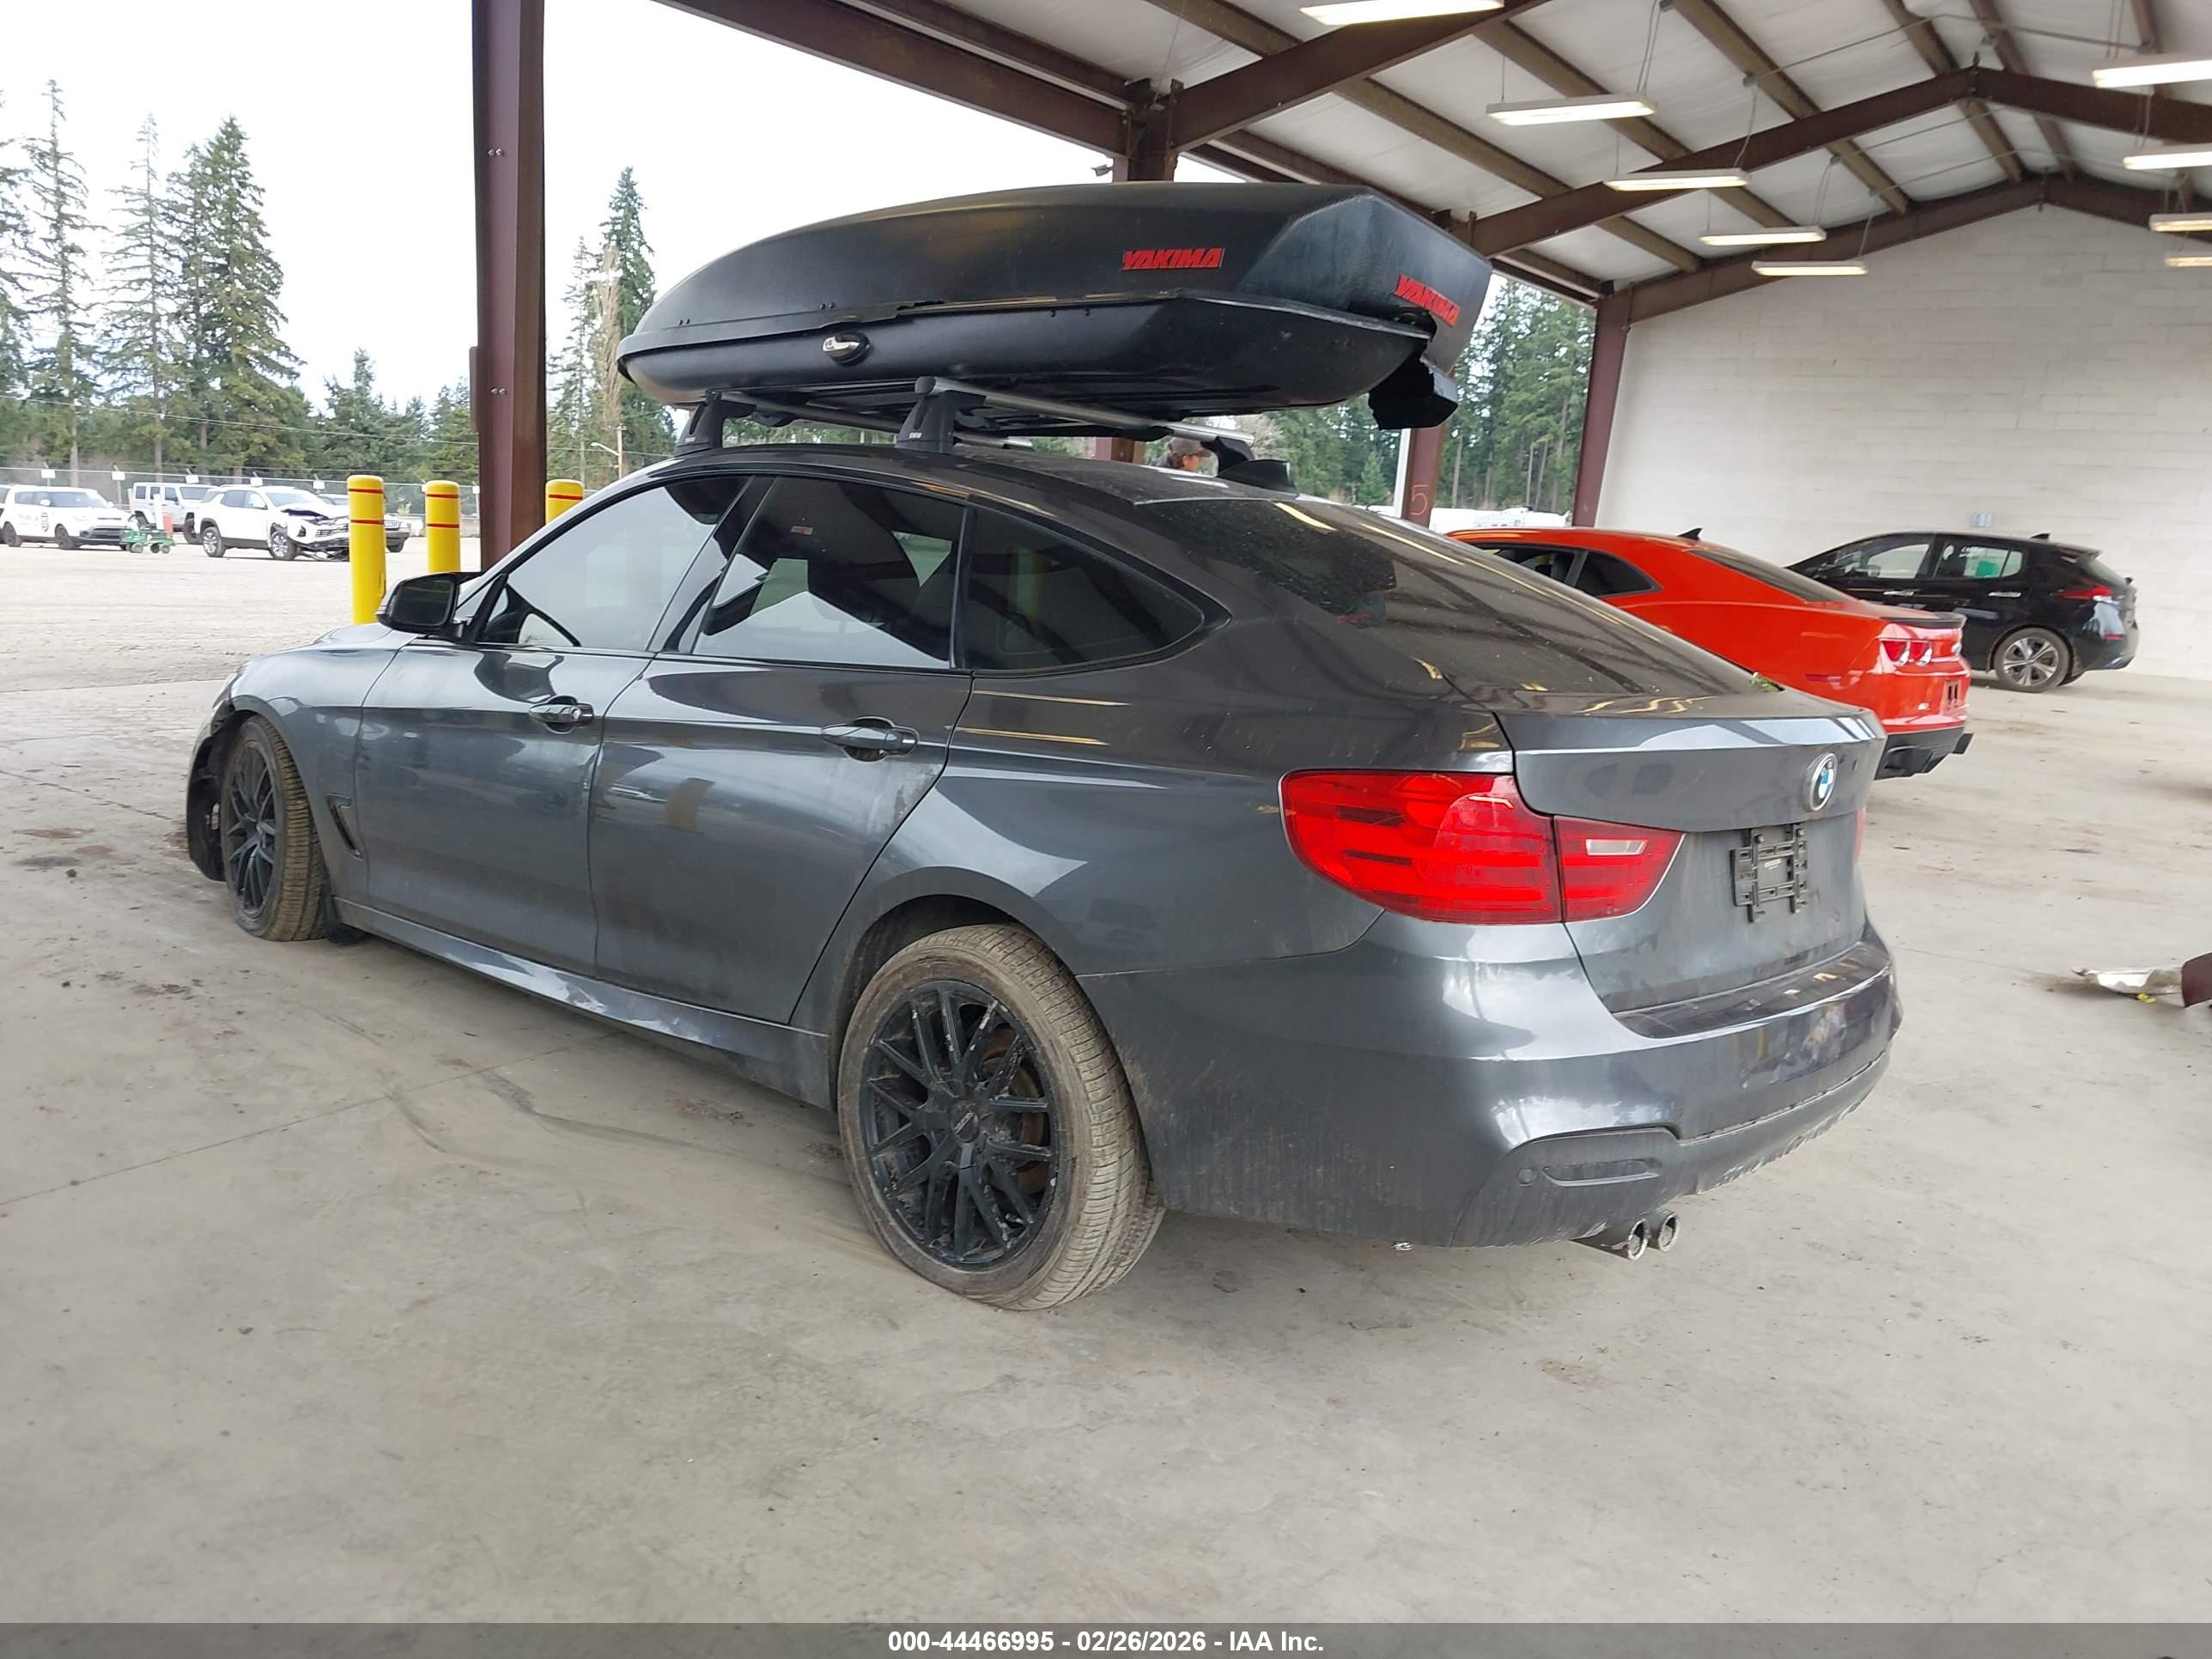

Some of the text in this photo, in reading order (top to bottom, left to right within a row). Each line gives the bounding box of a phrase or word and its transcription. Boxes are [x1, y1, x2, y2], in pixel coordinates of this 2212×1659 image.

[1121, 247, 1223, 270] YAKIMA
[1394, 275, 1460, 326] YAKIMA
[1410, 484, 1429, 515] 5
